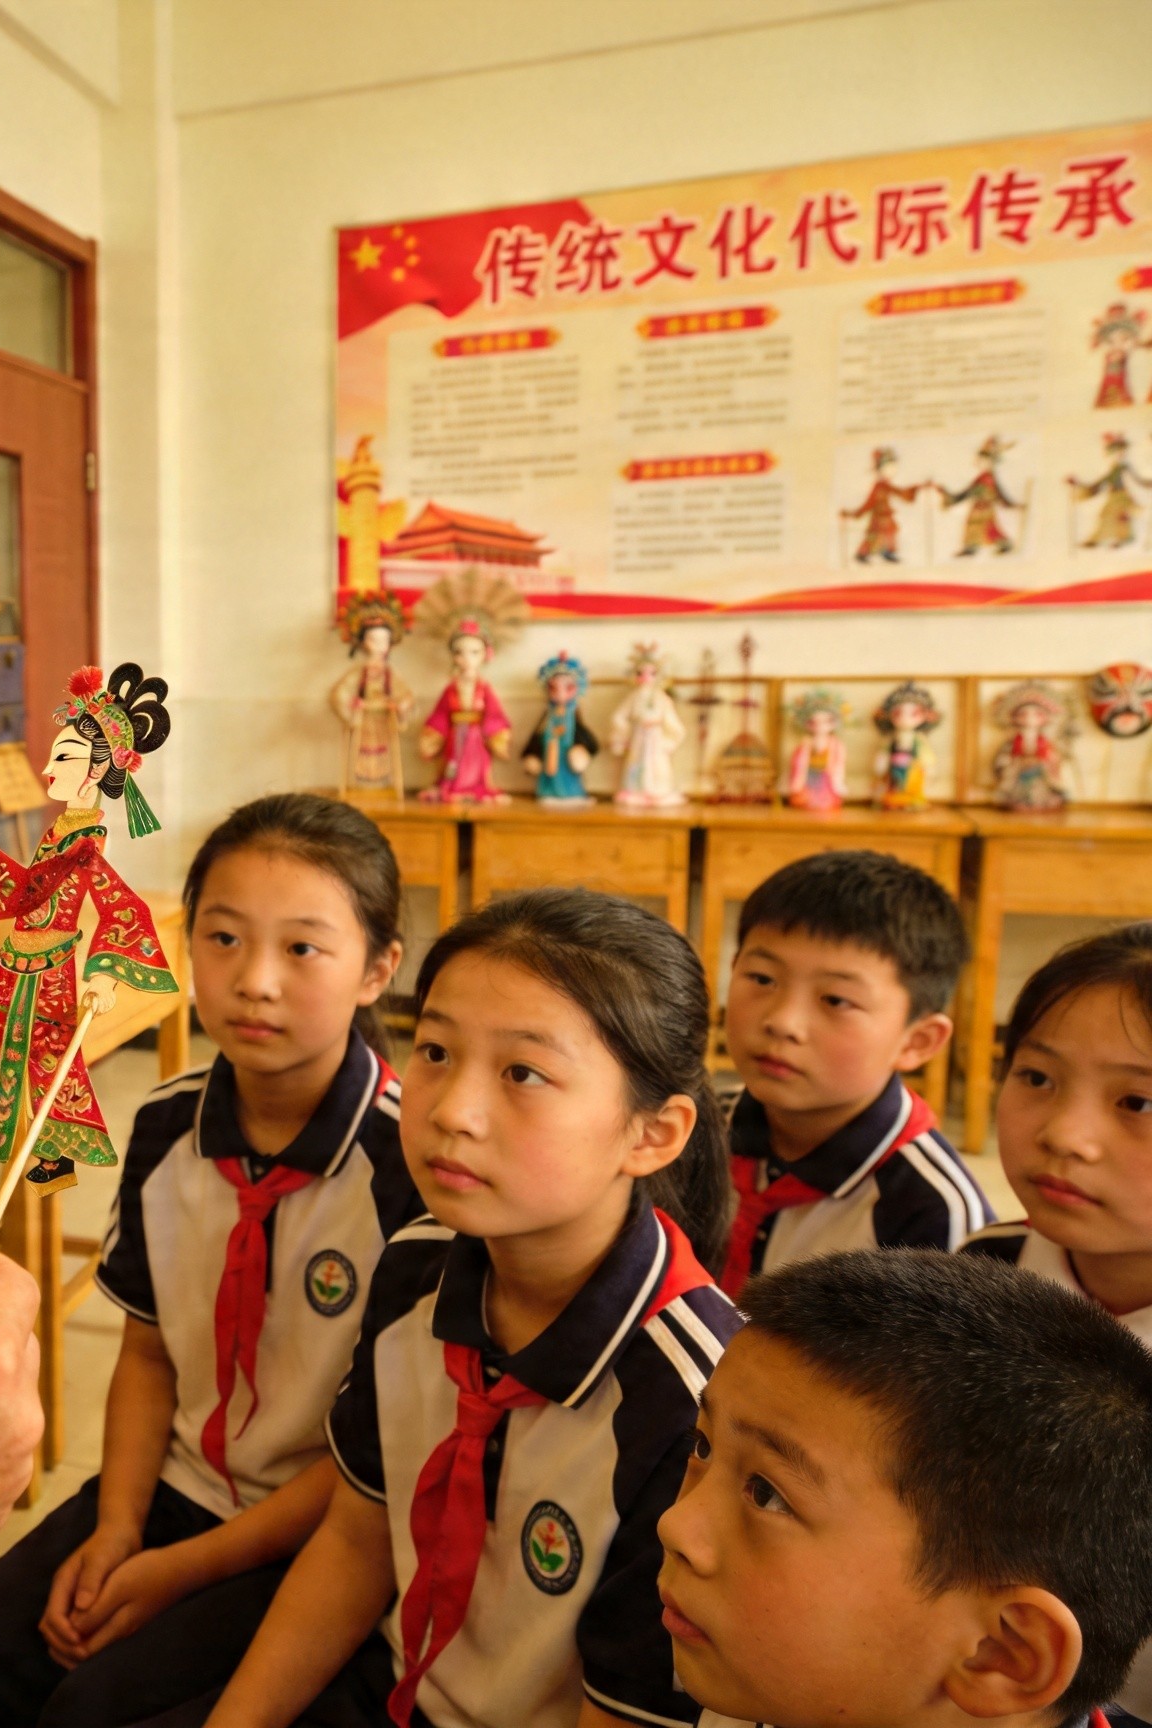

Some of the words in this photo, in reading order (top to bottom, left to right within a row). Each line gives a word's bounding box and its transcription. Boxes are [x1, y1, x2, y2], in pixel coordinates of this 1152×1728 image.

[484, 156, 1136, 303] 传统文化代际传承
